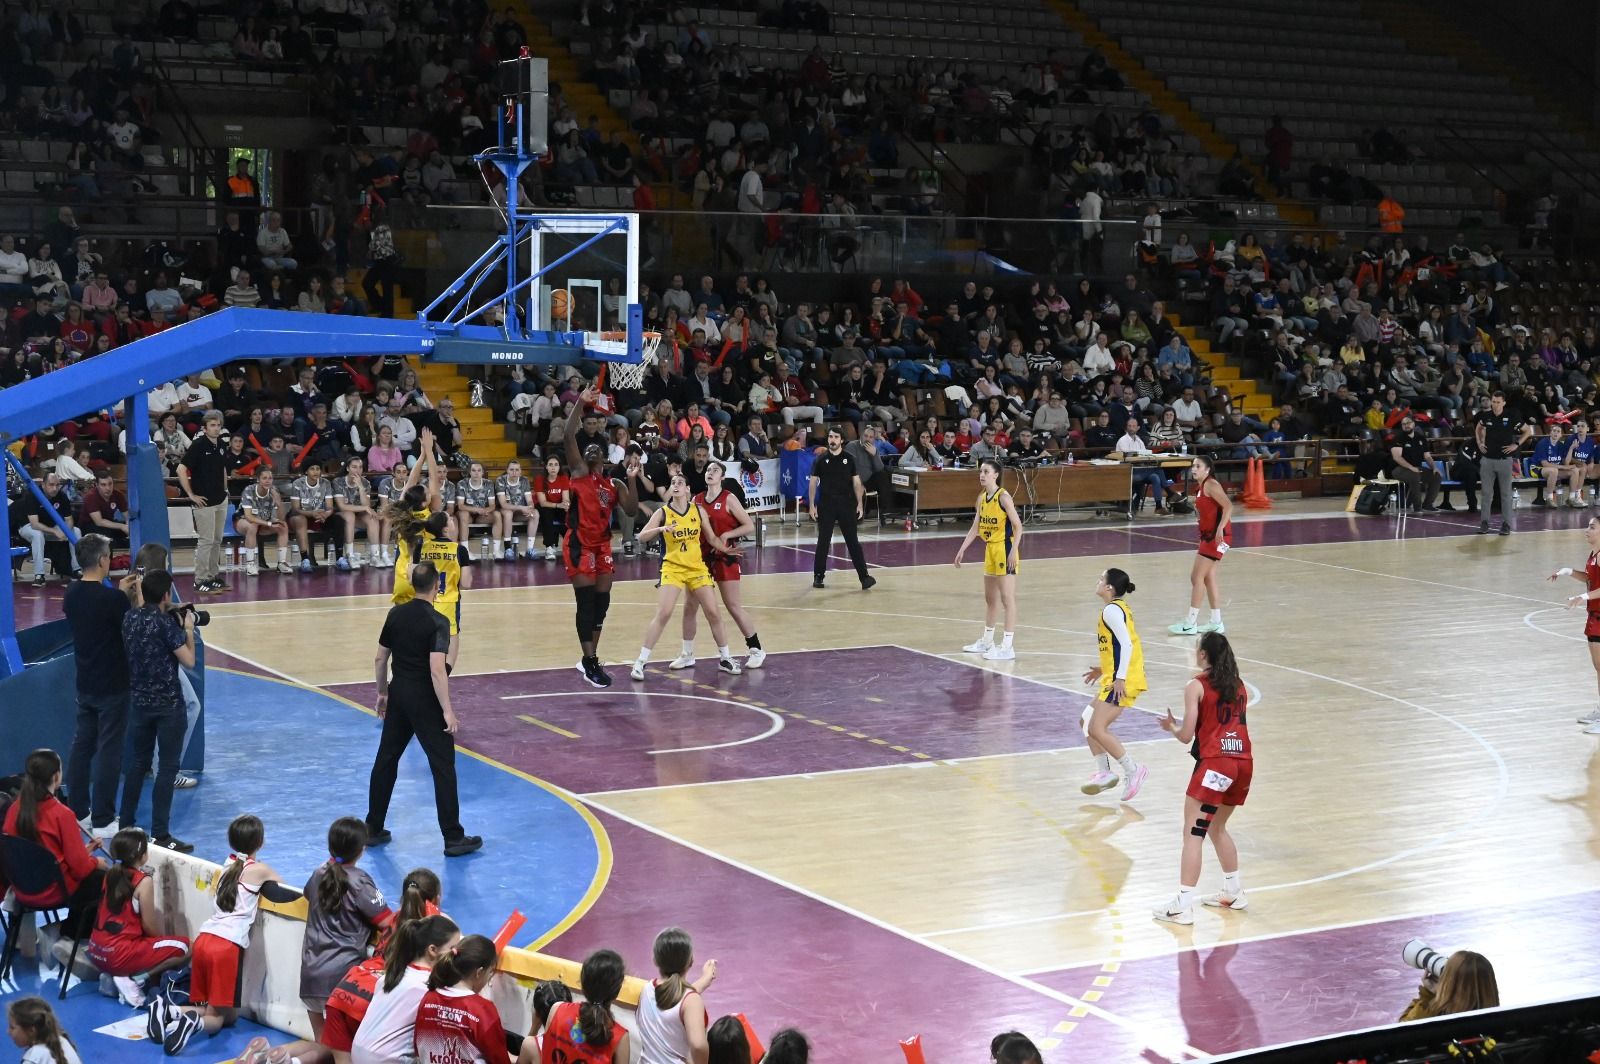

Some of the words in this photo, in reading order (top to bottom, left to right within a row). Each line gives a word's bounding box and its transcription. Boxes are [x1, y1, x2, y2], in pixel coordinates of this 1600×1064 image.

[491, 352, 524, 360] MONDO
[762, 495, 780, 506] TINO
[420, 552, 442, 561] CASES
[443, 552, 457, 561] REY
